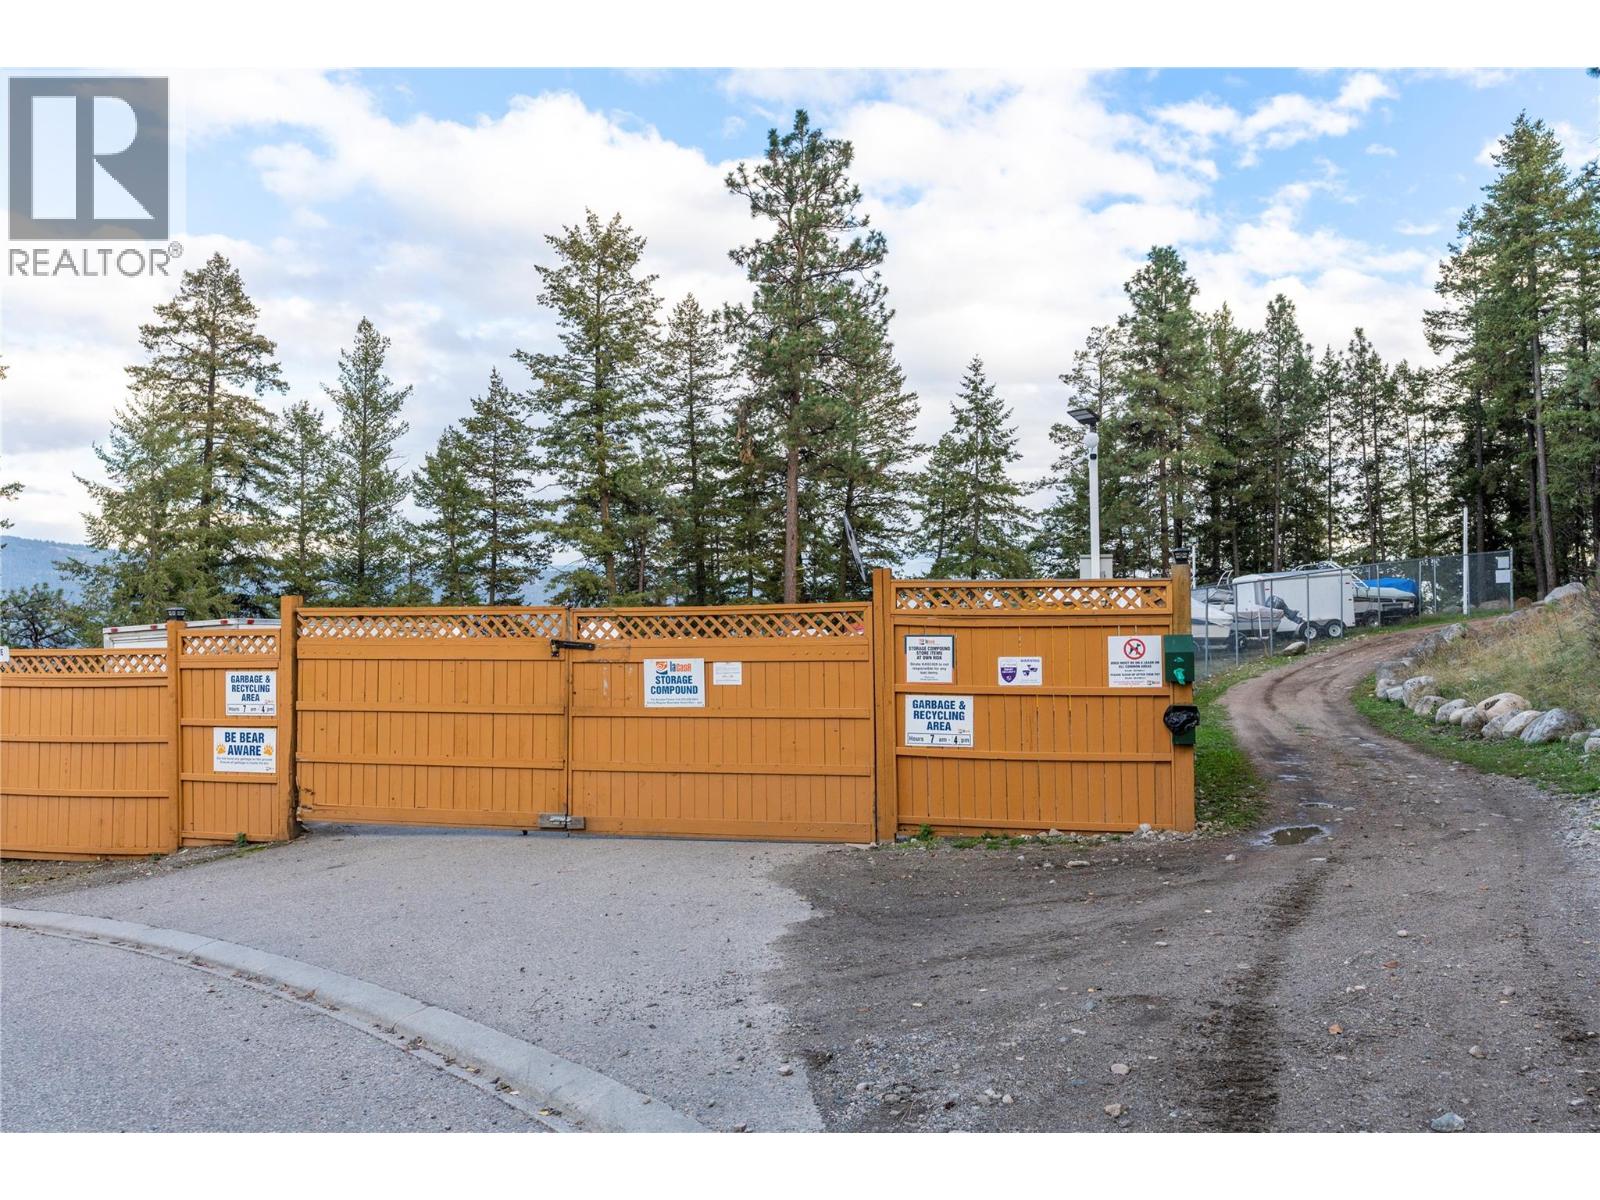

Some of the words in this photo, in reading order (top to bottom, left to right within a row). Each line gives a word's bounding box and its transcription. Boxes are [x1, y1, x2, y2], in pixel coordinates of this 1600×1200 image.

[231, 675, 262, 683] GARBAGE
[655, 676, 693, 684] STORAGE
[232, 684, 270, 692] RECYCLING
[650, 686, 698, 694] COMPOUND
[912, 700, 955, 710] GARBAGE
[959, 701, 966, 710] &
[913, 711, 965, 720] RECYCLING
[927, 722, 951, 731] AREA
[225, 732, 236, 742] BE
[240, 732, 264, 743] BEAR
[930, 734, 934, 743] 7
[954, 736, 958, 744] 4
[228, 745, 261, 756] AWARE
